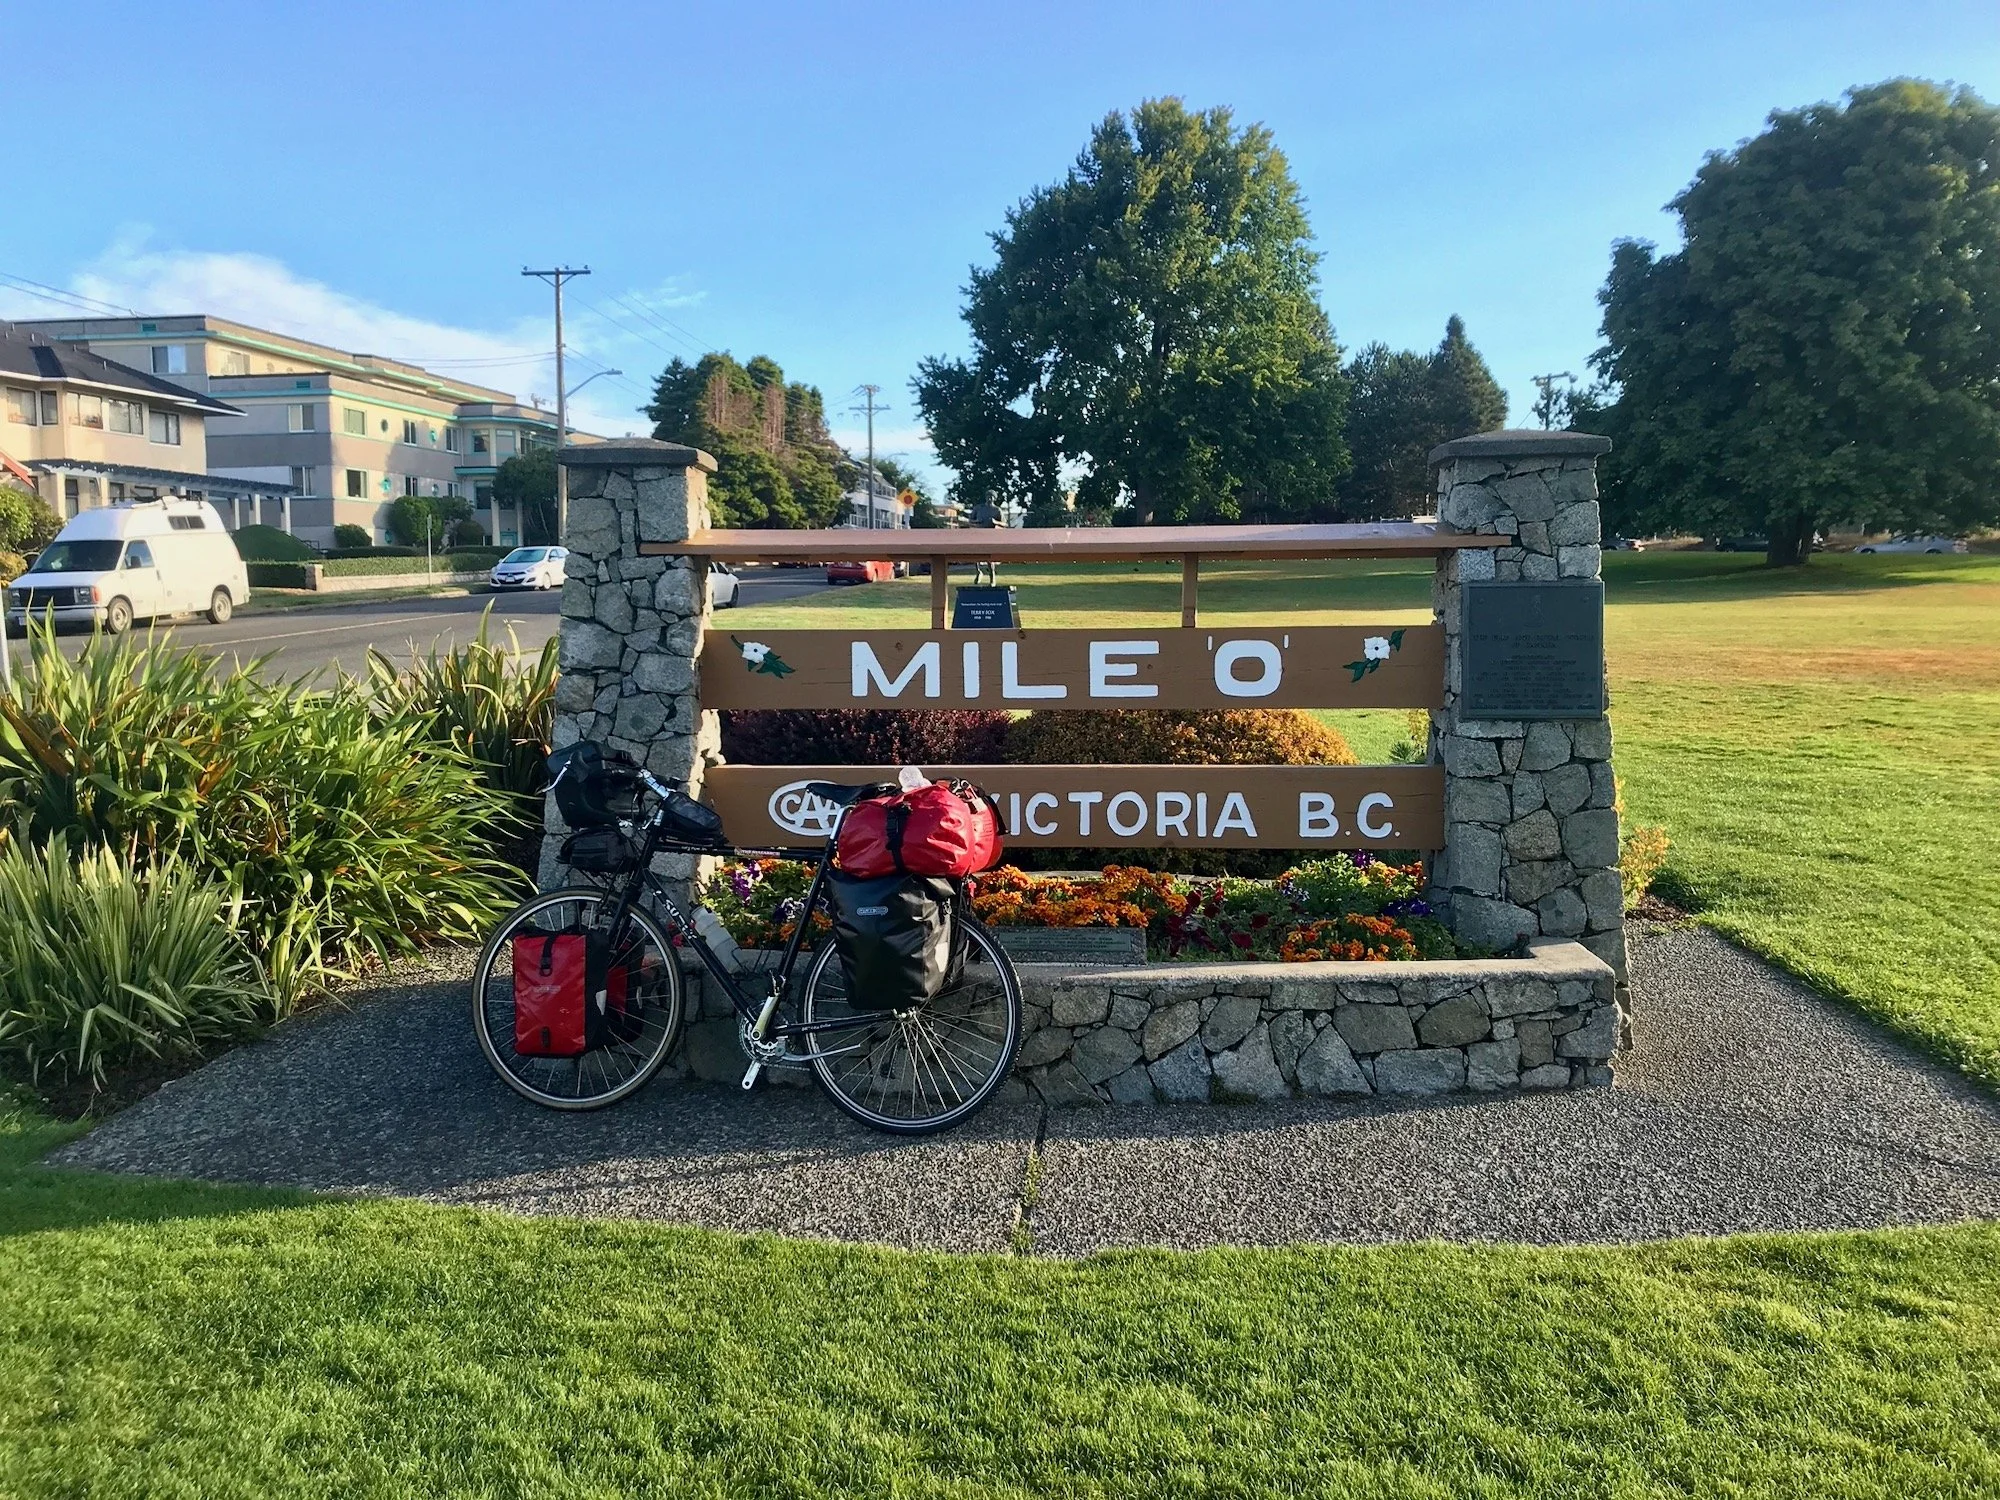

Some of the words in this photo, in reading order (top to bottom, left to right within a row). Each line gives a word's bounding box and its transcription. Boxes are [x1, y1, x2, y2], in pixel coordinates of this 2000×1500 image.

[851, 640, 1160, 699] MILE
[990, 791, 1258, 838] ICTORIA
[1299, 791, 1401, 839] B.C.
